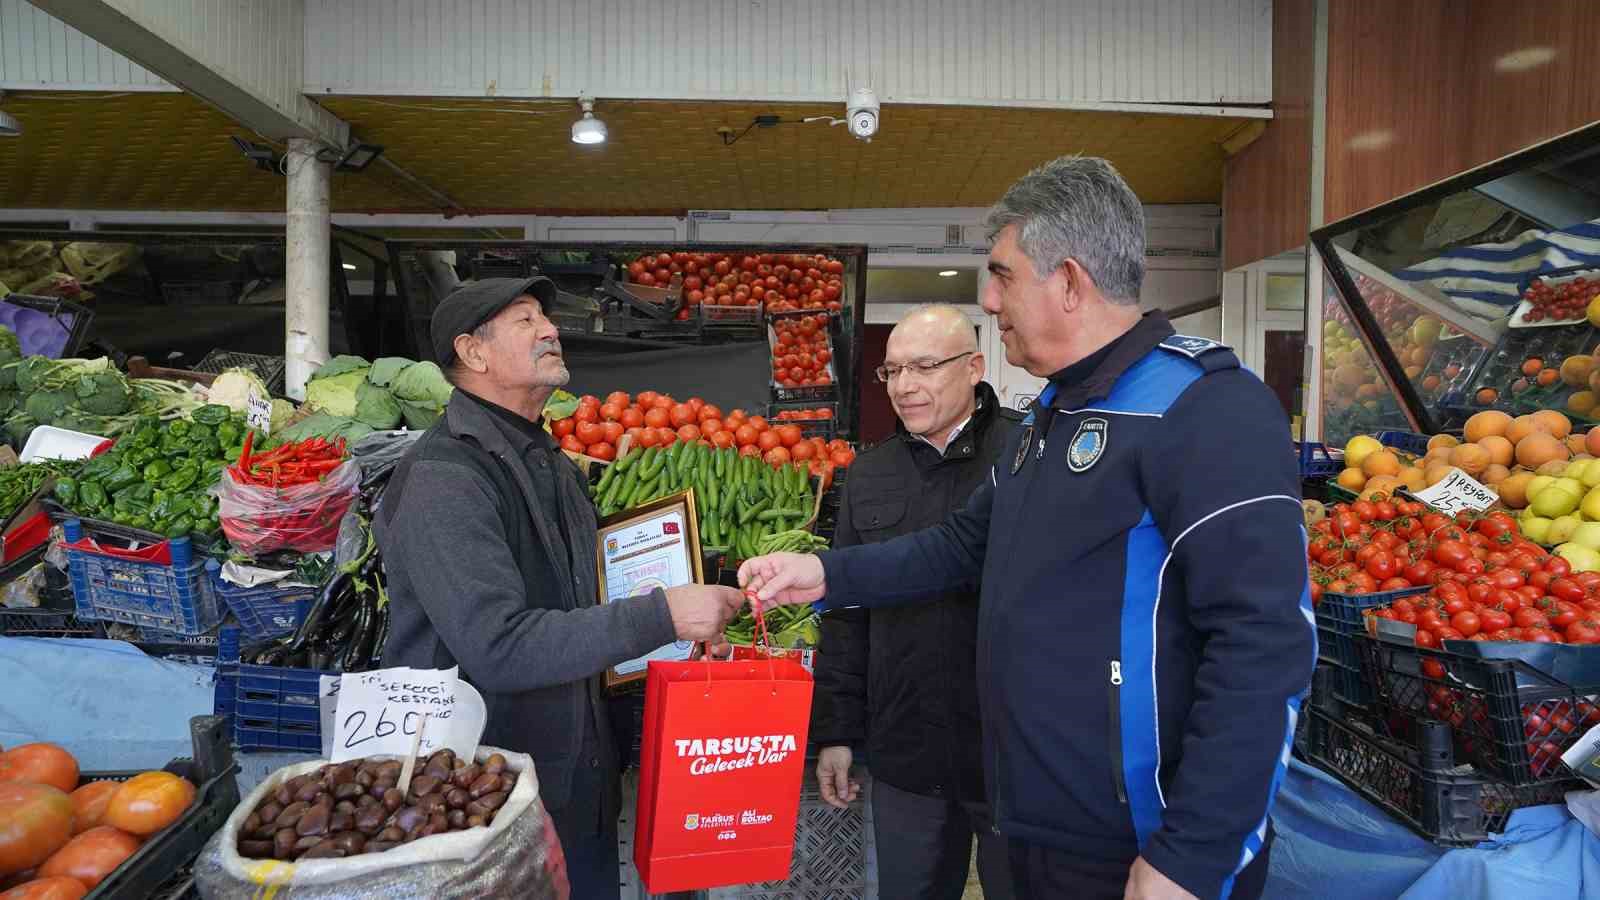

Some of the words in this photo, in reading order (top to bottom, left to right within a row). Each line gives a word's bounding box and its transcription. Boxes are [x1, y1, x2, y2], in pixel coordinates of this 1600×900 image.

[1430, 490, 1461, 511] 25
[675, 735, 797, 757] TARSUS'TA
[690, 752, 754, 775] Gelecek
[758, 747, 788, 765] Var
[701, 815, 734, 824] TARSUS
